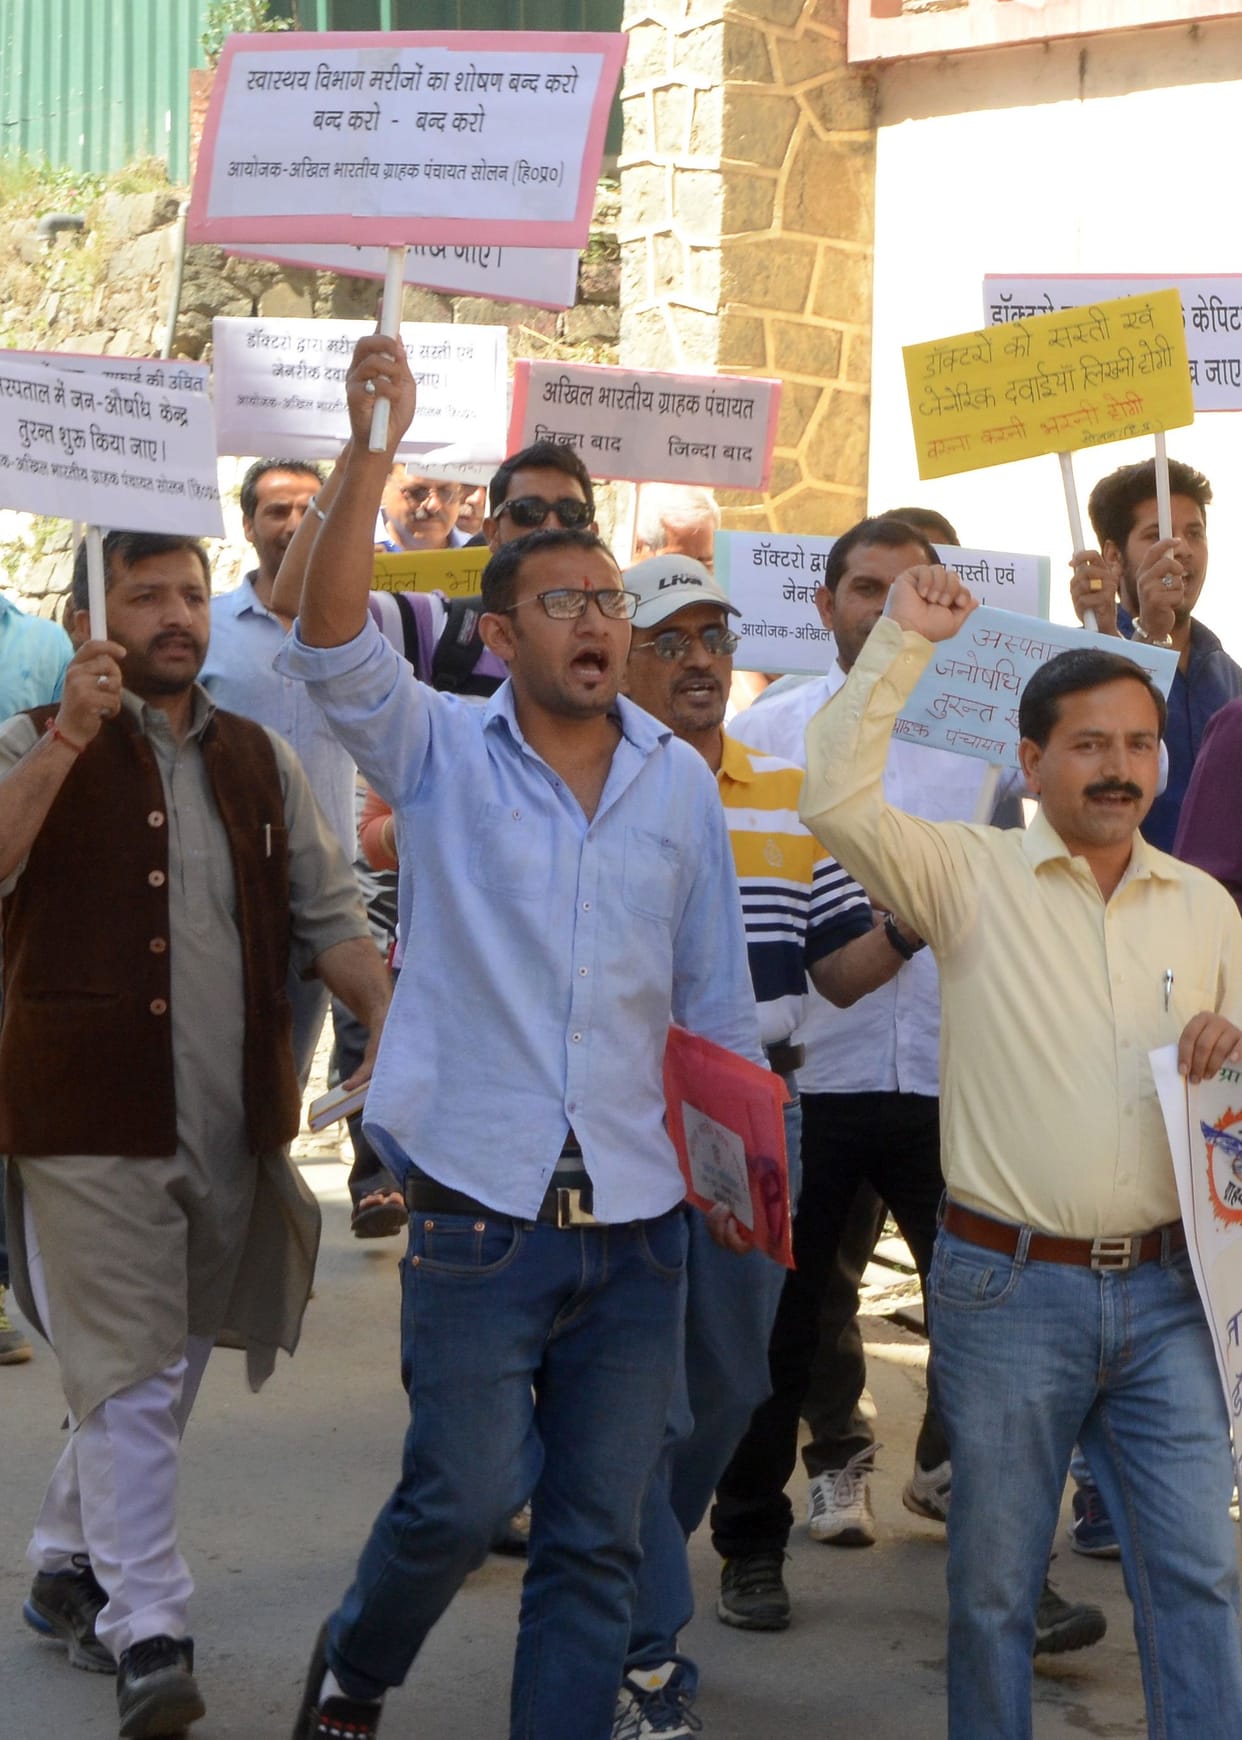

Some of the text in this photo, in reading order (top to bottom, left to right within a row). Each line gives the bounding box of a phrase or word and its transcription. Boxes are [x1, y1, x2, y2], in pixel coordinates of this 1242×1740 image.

[314, 62, 366, 91] विभाग
[369, 62, 423, 92] मरीजों
[426, 71, 451, 92] का
[454, 63, 504, 93] शोषण
[508, 73, 541, 94] बन्द
[545, 64, 579, 94] करो
[313, 110, 344, 132] बन्द
[347, 101, 381, 132] करो
[416, 111, 448, 132] बन्द
[452, 103, 486, 133] करो
[333, 156, 380, 179] भारतीय
[383, 162, 421, 182] ग्राहक
[423, 158, 467, 181] पंचायत
[471, 158, 510, 182] सोलन
[1003, 322, 1033, 359] को
[146, 368, 165, 388] की
[168, 369, 204, 392] उचित
[54, 378, 66, 409] में
[159, 394, 189, 428] केन्द्र
[542, 375, 754, 420] अखिल भारतीय ग्राहक पंचायत
[18, 418, 55, 449] तुरन्त
[89, 422, 125, 455] किया
[590, 435, 623, 453] बाद
[667, 434, 716, 459] जिन्दा
[722, 444, 753, 463] बाद
[752, 541, 805, 569] डॉक्टरो
[993, 562, 1016, 585] एवं
[924, 692, 999, 723] तुरन्त
